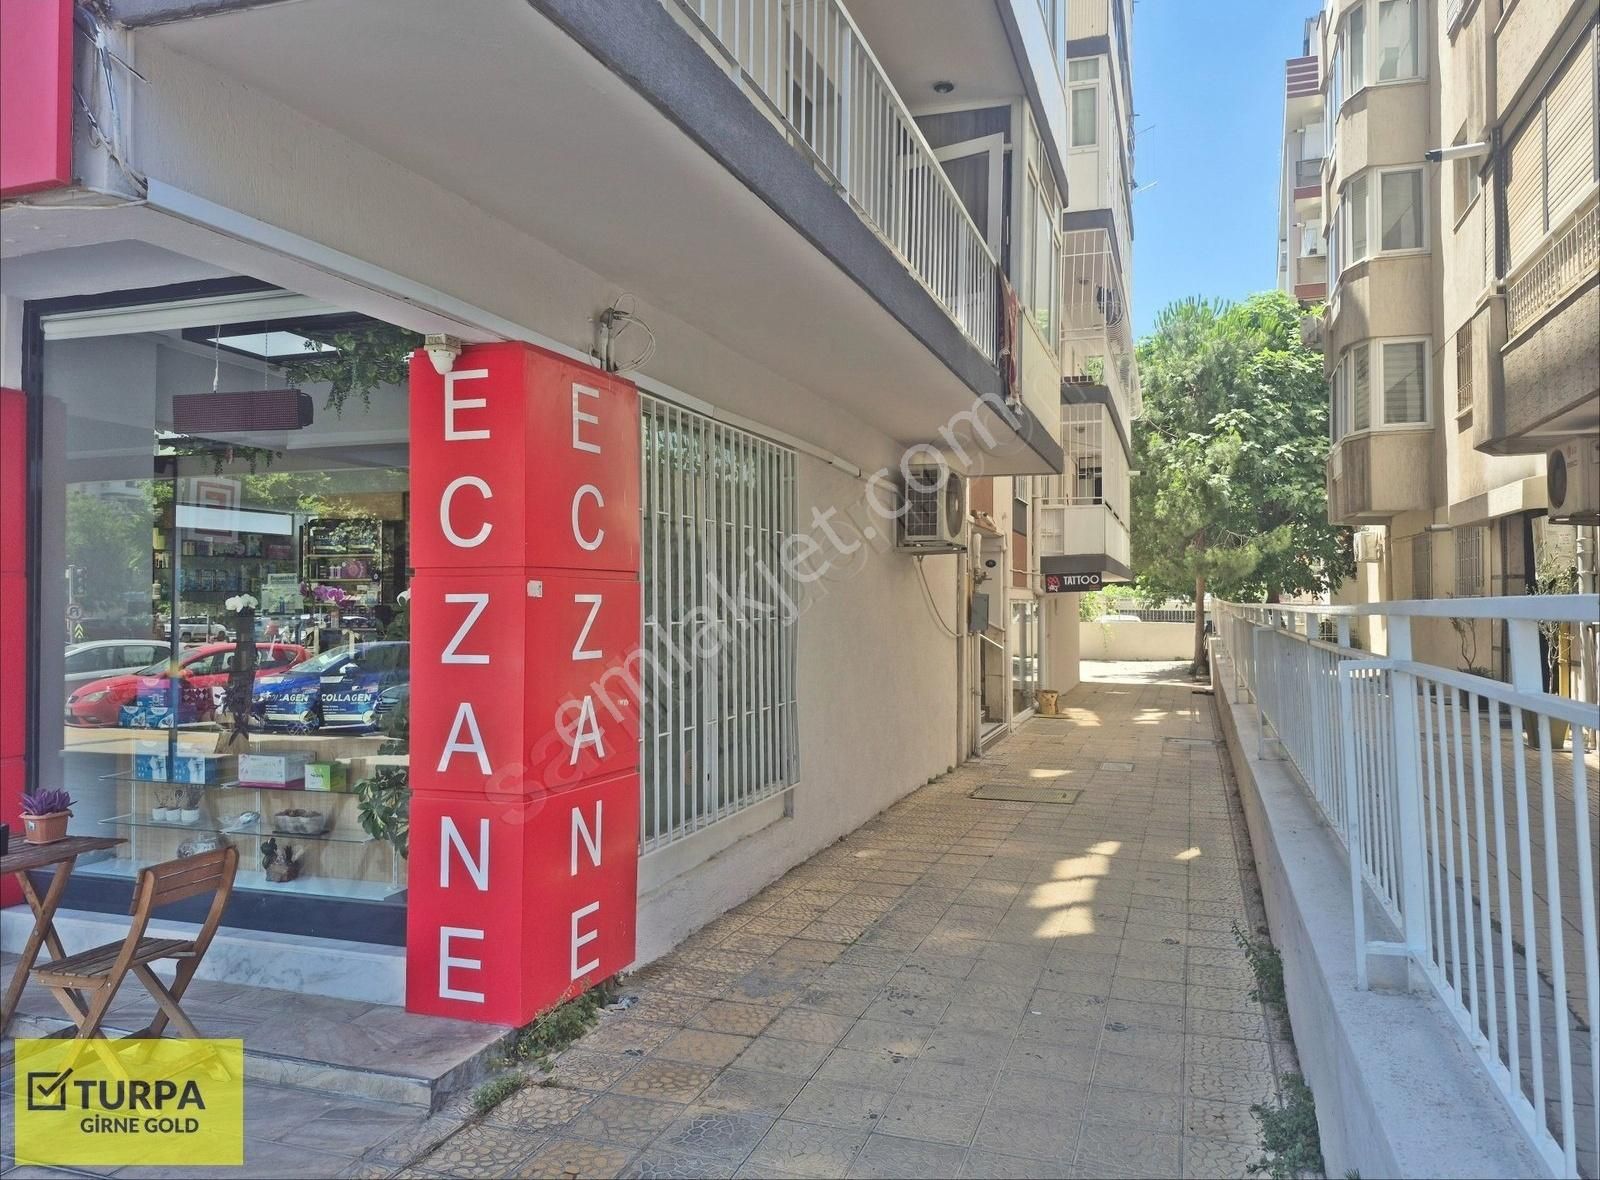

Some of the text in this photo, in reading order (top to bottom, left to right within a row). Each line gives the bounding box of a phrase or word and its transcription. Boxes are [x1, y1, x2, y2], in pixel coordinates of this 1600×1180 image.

[321, 693, 372, 702] COLLAGEN
[436, 366, 493, 1004] ECZANE
[570, 381, 605, 982] ECZANE
[1063, 574, 1099, 585] TATTOO
